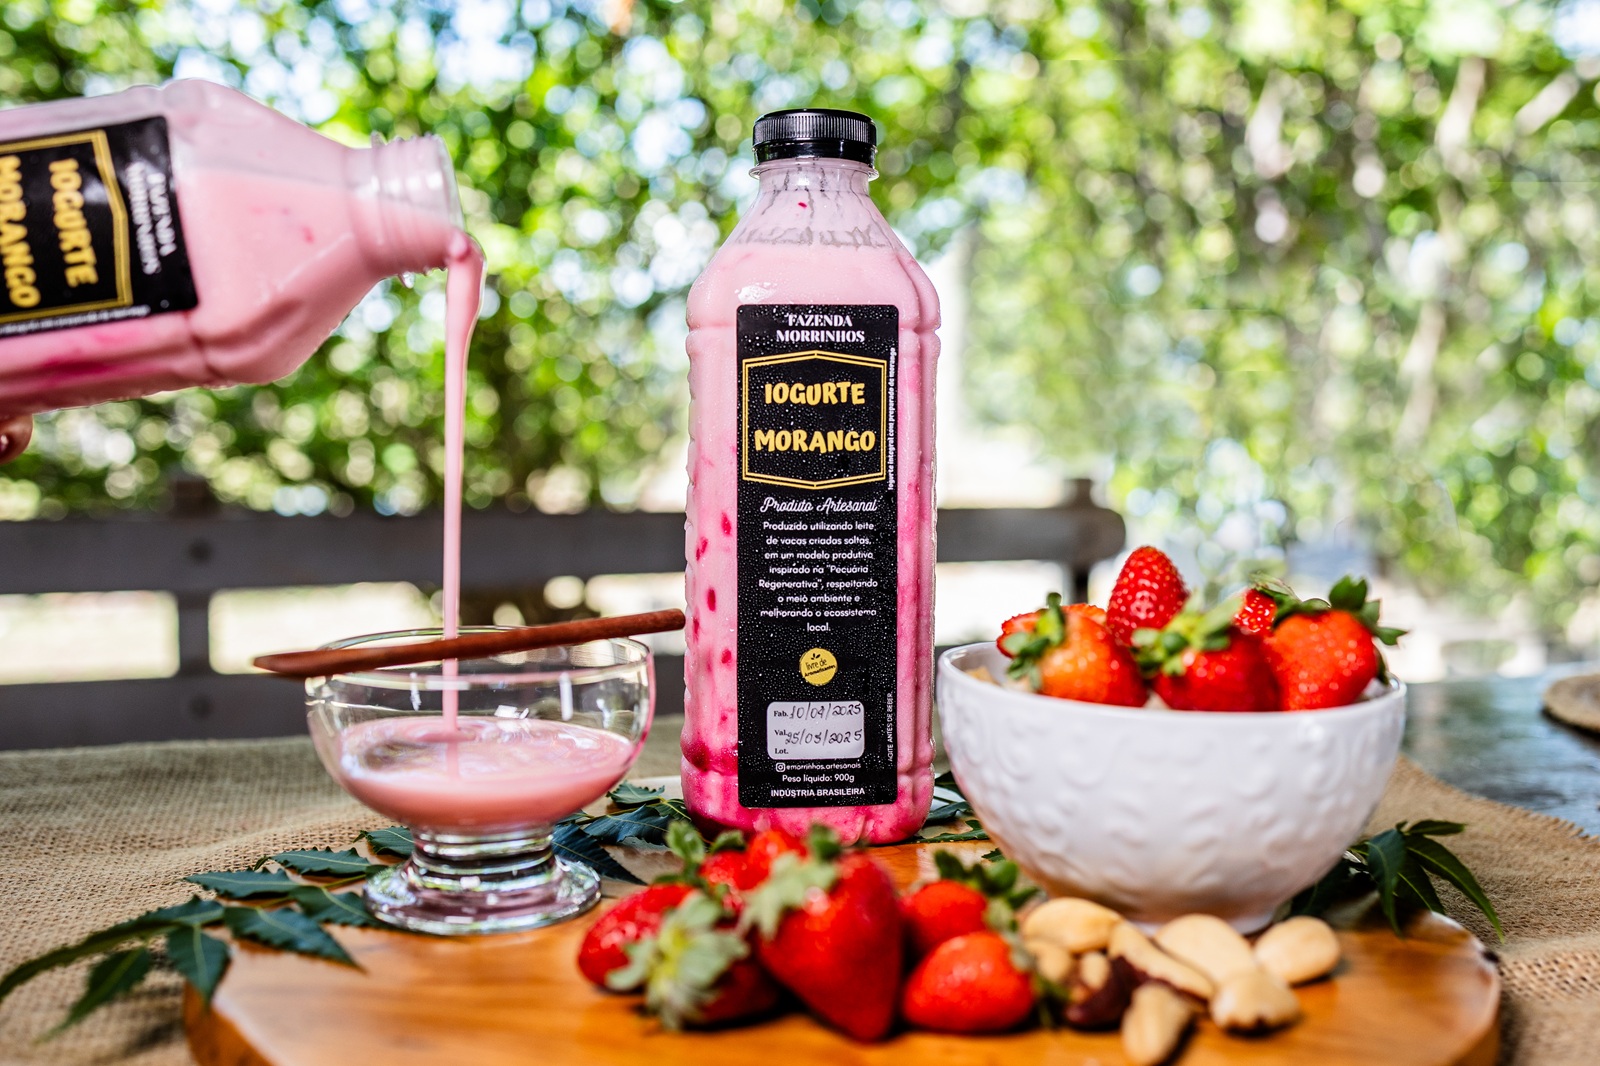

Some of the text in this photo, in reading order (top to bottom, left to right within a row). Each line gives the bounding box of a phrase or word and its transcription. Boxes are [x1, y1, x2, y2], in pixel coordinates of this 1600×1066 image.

[48, 158, 98, 287] IOGURTE
[787, 314, 852, 327] FAZENDA
[776, 330, 865, 343] MORRINHOS
[889, 347, 897, 377] morango
[764, 381, 865, 406] IOGURTE
[888, 387, 896, 422] preparado
[754, 429, 876, 454] MORANGO
[887, 437, 895, 464] integral
[760, 496, 878, 514] Produto Artesanal
[763, 521, 875, 531] Produzido utilizando leite
[766, 535, 779, 545] de
[780, 537, 807, 545] vacas
[808, 536, 843, 545] criadas
[764, 550, 873, 562] em um modelo produtivo
[769, 564, 869, 576] inspirado na "Pecuária
[826, 578, 878, 589] respeitando
[786, 593, 809, 603] meio
[810, 593, 853, 603] ambiente
[760, 607, 877, 618] melhorando o ecossistema
[806, 622, 832, 632] local.
[819, 657, 828, 667] de
[774, 747, 789, 755] Lot.
[782, 773, 855, 784] Peso líquido: 900g
[770, 787, 866, 798] INDÚSTRIA BRASILEIRA
